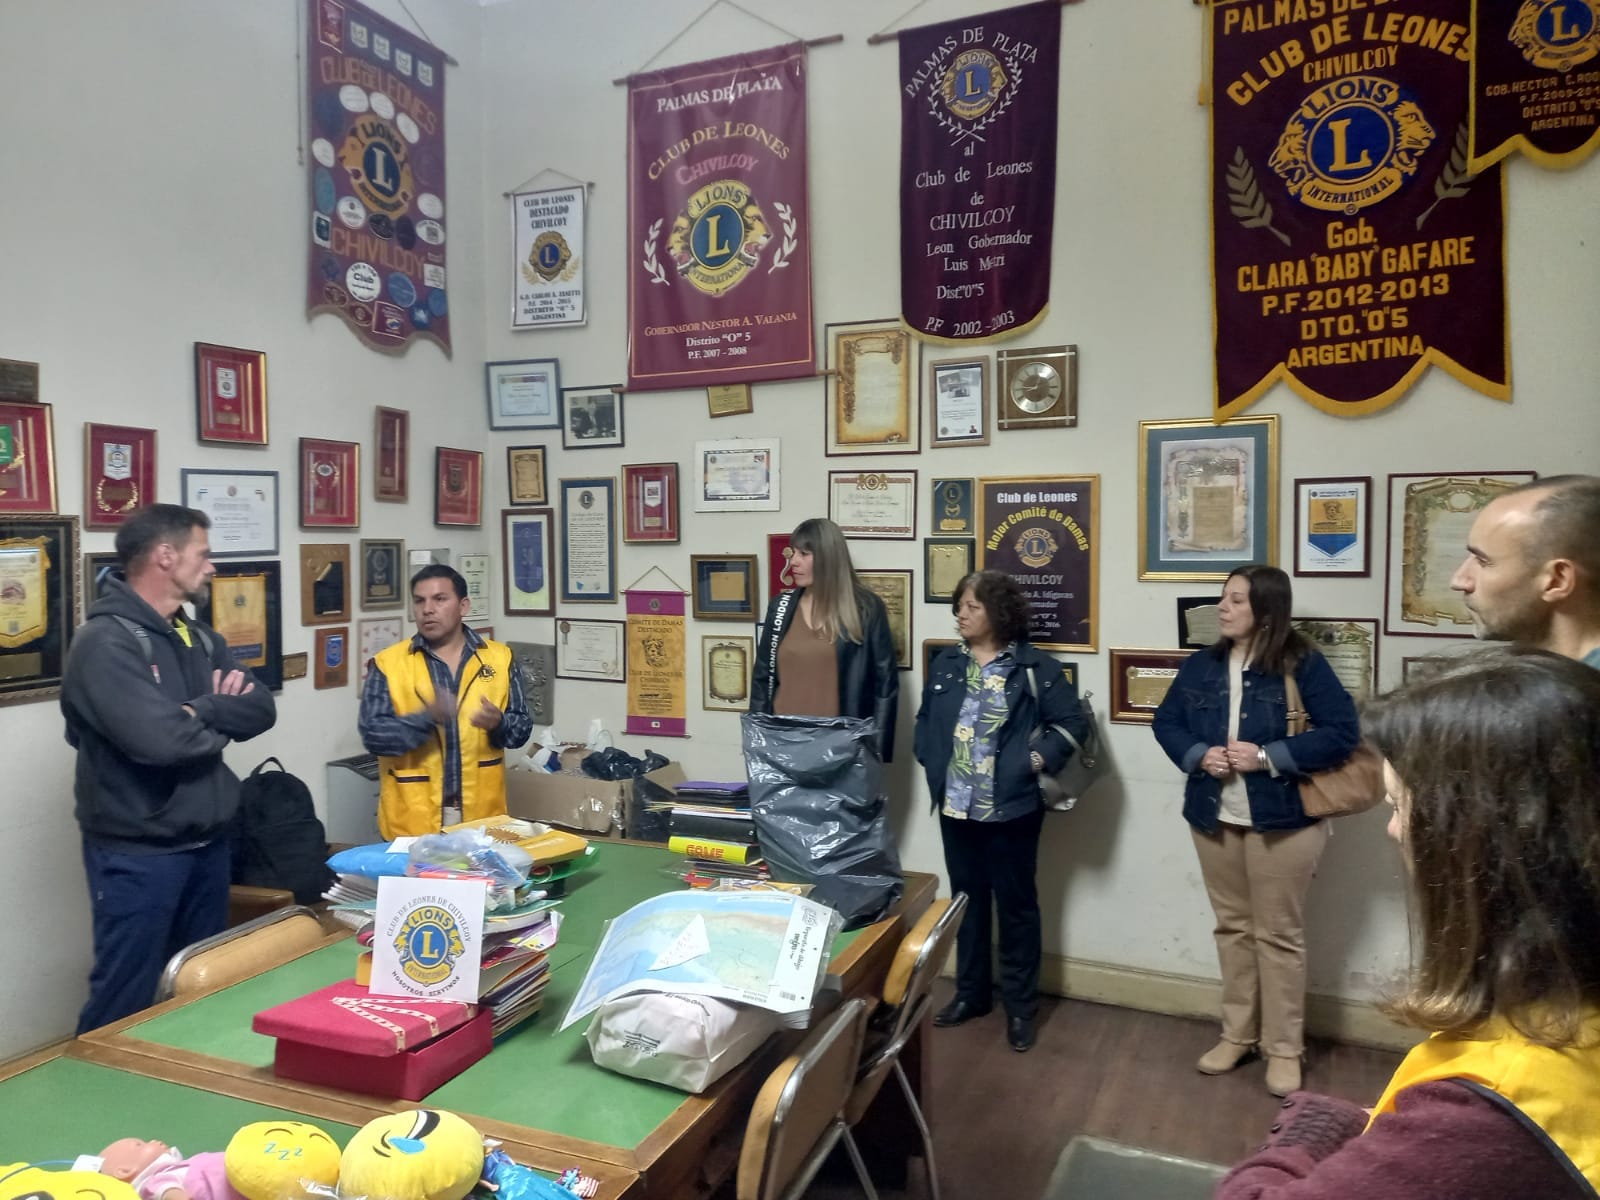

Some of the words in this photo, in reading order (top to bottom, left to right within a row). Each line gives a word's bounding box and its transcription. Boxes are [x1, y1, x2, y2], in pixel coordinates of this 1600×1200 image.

[1224, 0, 1327, 35] PALMAS
[1550, 6, 1580, 42] L
[904, 36, 958, 98] PALMAS
[962, 26, 984, 44] DE
[992, 32, 1038, 64] PLATA
[1226, 39, 1306, 107] CLUB
[1310, 15, 1351, 54] DE
[1363, 12, 1472, 62] LEONES
[1303, 45, 1399, 84] CHIVILCOY
[657, 90, 709, 112] PALMAS
[711, 87, 733, 103] DE
[737, 76, 783, 99] PLATA
[965, 71, 981, 97] L
[1305, 78, 1395, 116] LIONS
[648, 137, 691, 180] CLUB
[692, 126, 719, 145] DE
[724, 121, 790, 160] LEONES
[964, 141, 975, 157] al
[1328, 118, 1373, 173] L
[372, 147, 393, 191] L
[675, 153, 759, 186] CHIVILCOY
[915, 169, 946, 188] Club
[954, 166, 972, 183] de
[986, 160, 1033, 179] Leones
[694, 185, 744, 211] LIONS
[970, 190, 984, 206] de
[1306, 176, 1395, 205] INTERNATIONAL
[930, 205, 1015, 231] CHIVILCOY
[1326, 218, 1378, 249] Gob.
[706, 214, 731, 259] L
[926, 242, 954, 257] Leon
[968, 230, 1033, 250] Gobernador
[944, 257, 968, 271] Luis
[1237, 258, 1308, 293] CLARA
[1381, 236, 1475, 276] GAFARE
[1262, 274, 1450, 318] P.F.2012-2013
[644, 322, 700, 337] GOBERNADOR
[701, 318, 741, 331] NESTOR
[742, 316, 753, 326] A.
[754, 312, 799, 326] VALANIA
[686, 336, 721, 347] Distrito
[744, 332, 752, 342] 5
[953, 320, 983, 337] 2002
[1301, 315, 1361, 341] DTO.
[688, 351, 702, 360] P.F.
[703, 349, 721, 359] 2007
[1287, 334, 1425, 369] ARGENTINA
[997, 491, 1022, 504] Club
[1022, 491, 1038, 503] de
[1038, 491, 1079, 503] Leones
[1007, 506, 1048, 526] Comité
[1048, 508, 1064, 522] de
[1062, 515, 1090, 551] Damas
[1031, 540, 1044, 555] L
[773, 594, 792, 632] LONDON
[387, 915, 400, 937] CLUB
[437, 897, 448, 906] DE
[411, 909, 452, 927] LIONS
[420, 931, 440, 958] L
